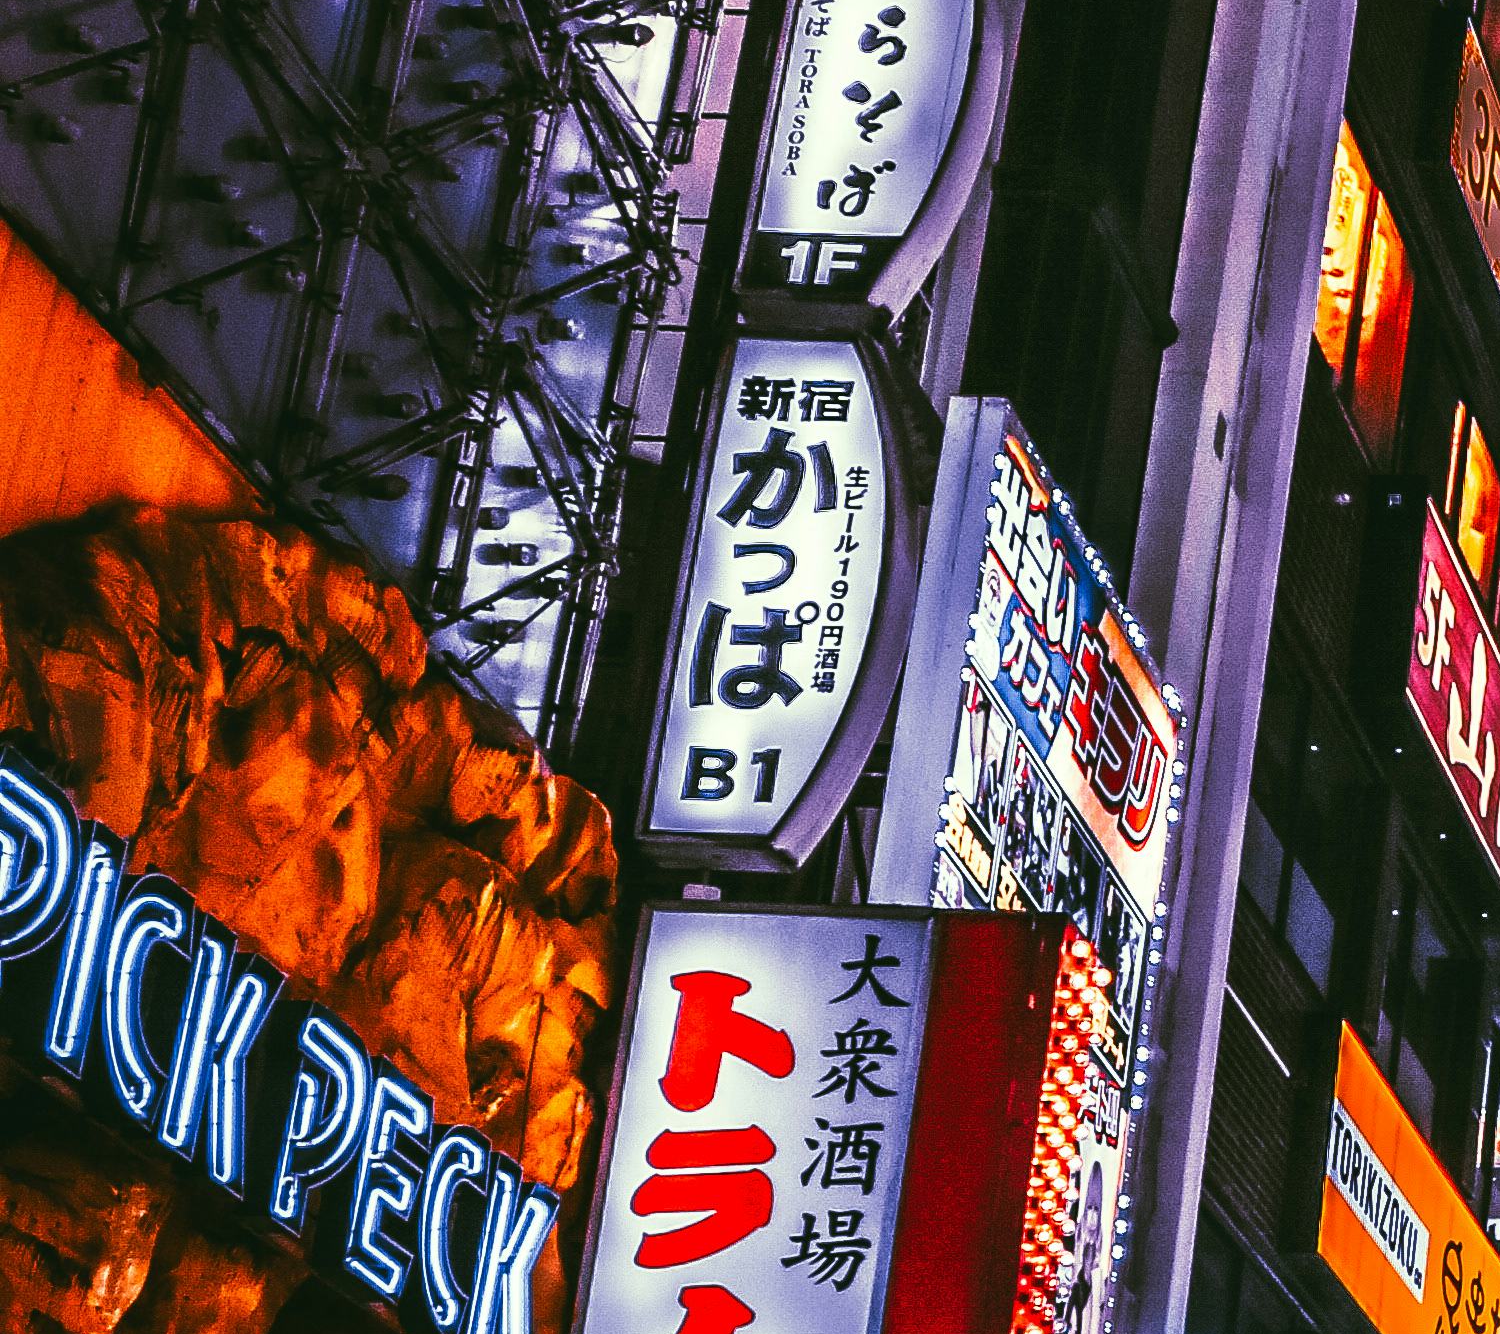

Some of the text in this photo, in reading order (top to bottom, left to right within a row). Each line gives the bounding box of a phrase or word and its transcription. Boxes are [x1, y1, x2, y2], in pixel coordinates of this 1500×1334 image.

[780, 48, 821, 178] TORA SOBA
[779, 241, 864, 286] 1F
[737, 375, 856, 423] 新宿
[688, 426, 838, 710] かっぱ
[810, 465, 871, 694] 生ビール190円酒場
[1420, 559, 1457, 692] 5F
[680, 746, 783, 804] B1
[780, 934, 913, 1293] 大衆酒場
[1329, 1100, 1423, 1298] TORIKIZOKU
